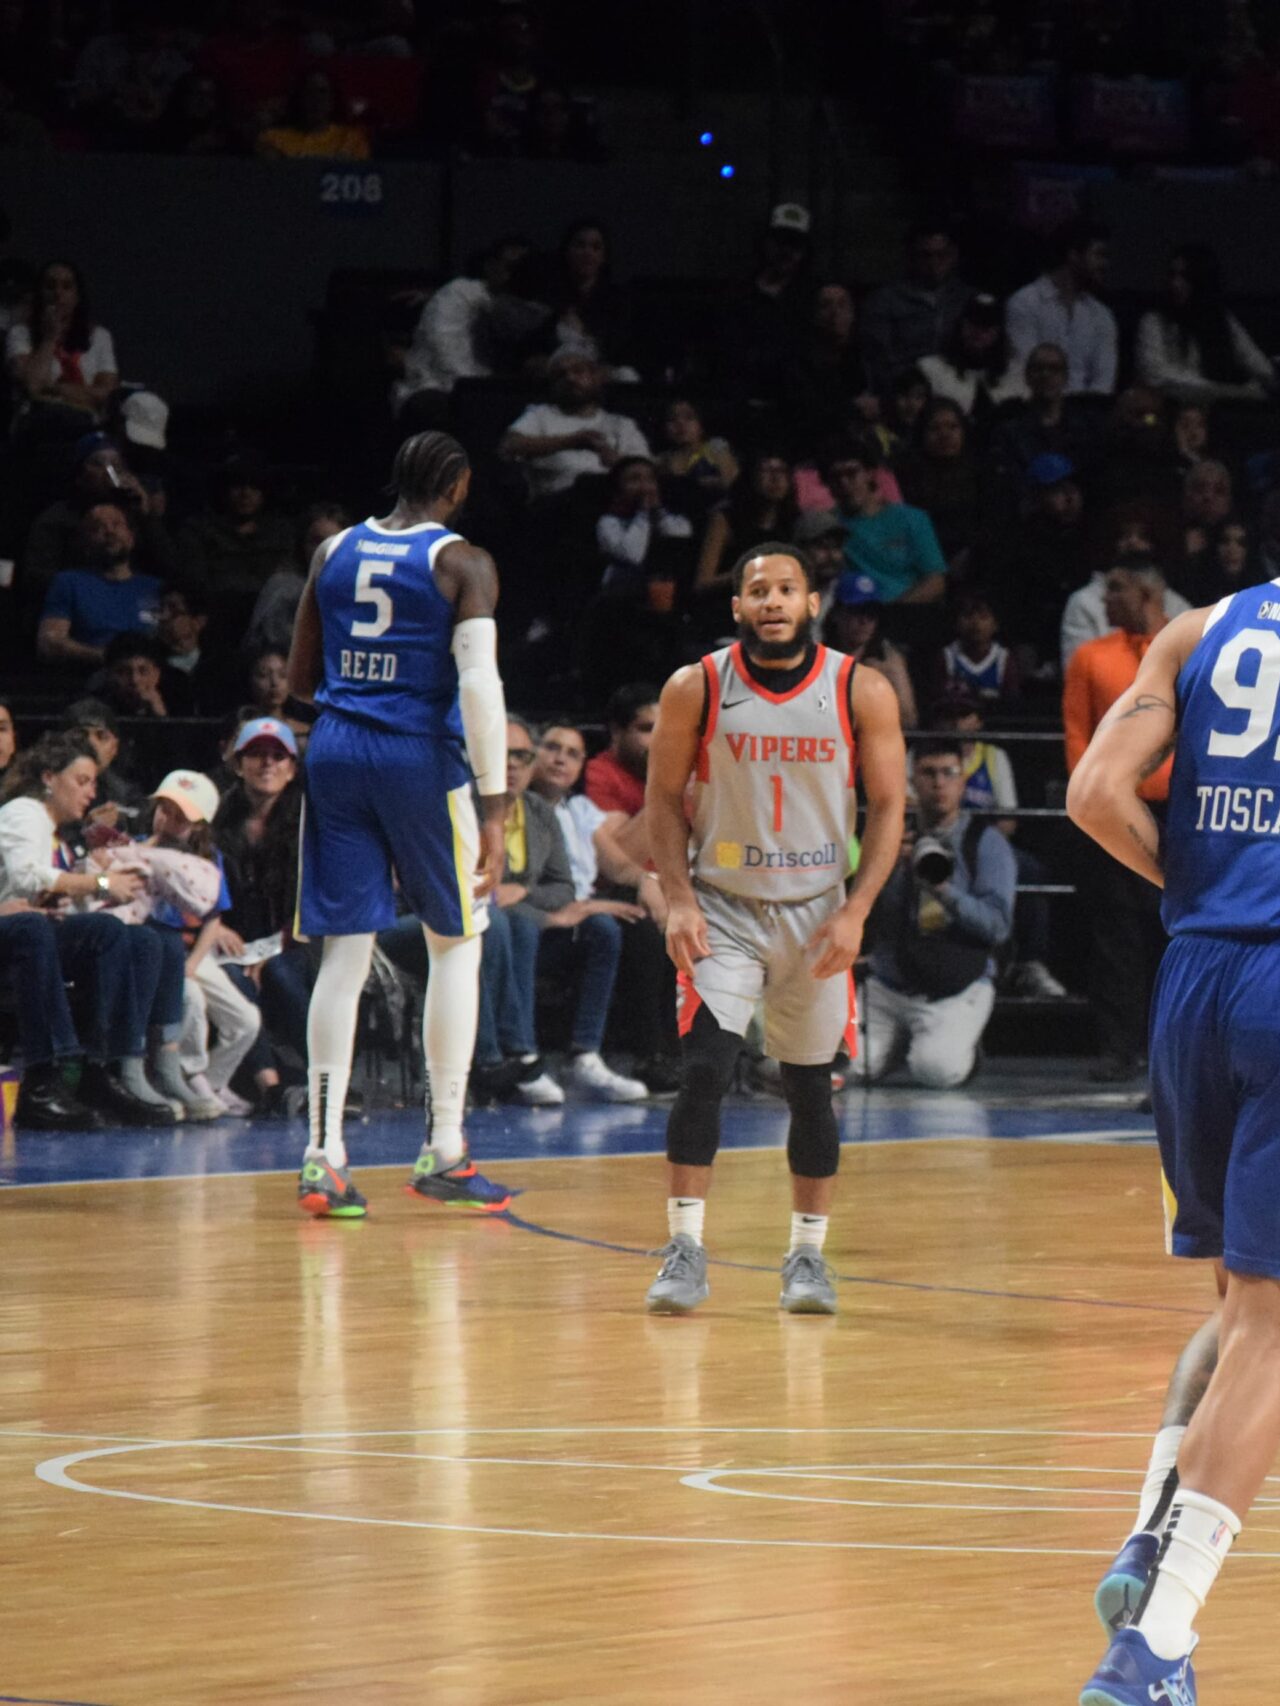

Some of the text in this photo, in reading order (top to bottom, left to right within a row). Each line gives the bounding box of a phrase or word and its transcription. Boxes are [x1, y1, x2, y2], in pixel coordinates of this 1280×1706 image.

[320, 172, 383, 202] 208
[351, 560, 394, 637] 5
[340, 650, 397, 682] REED
[725, 733, 836, 763] VIPERS
[769, 774, 783, 832] 1
[744, 843, 836, 867] Driscoll
